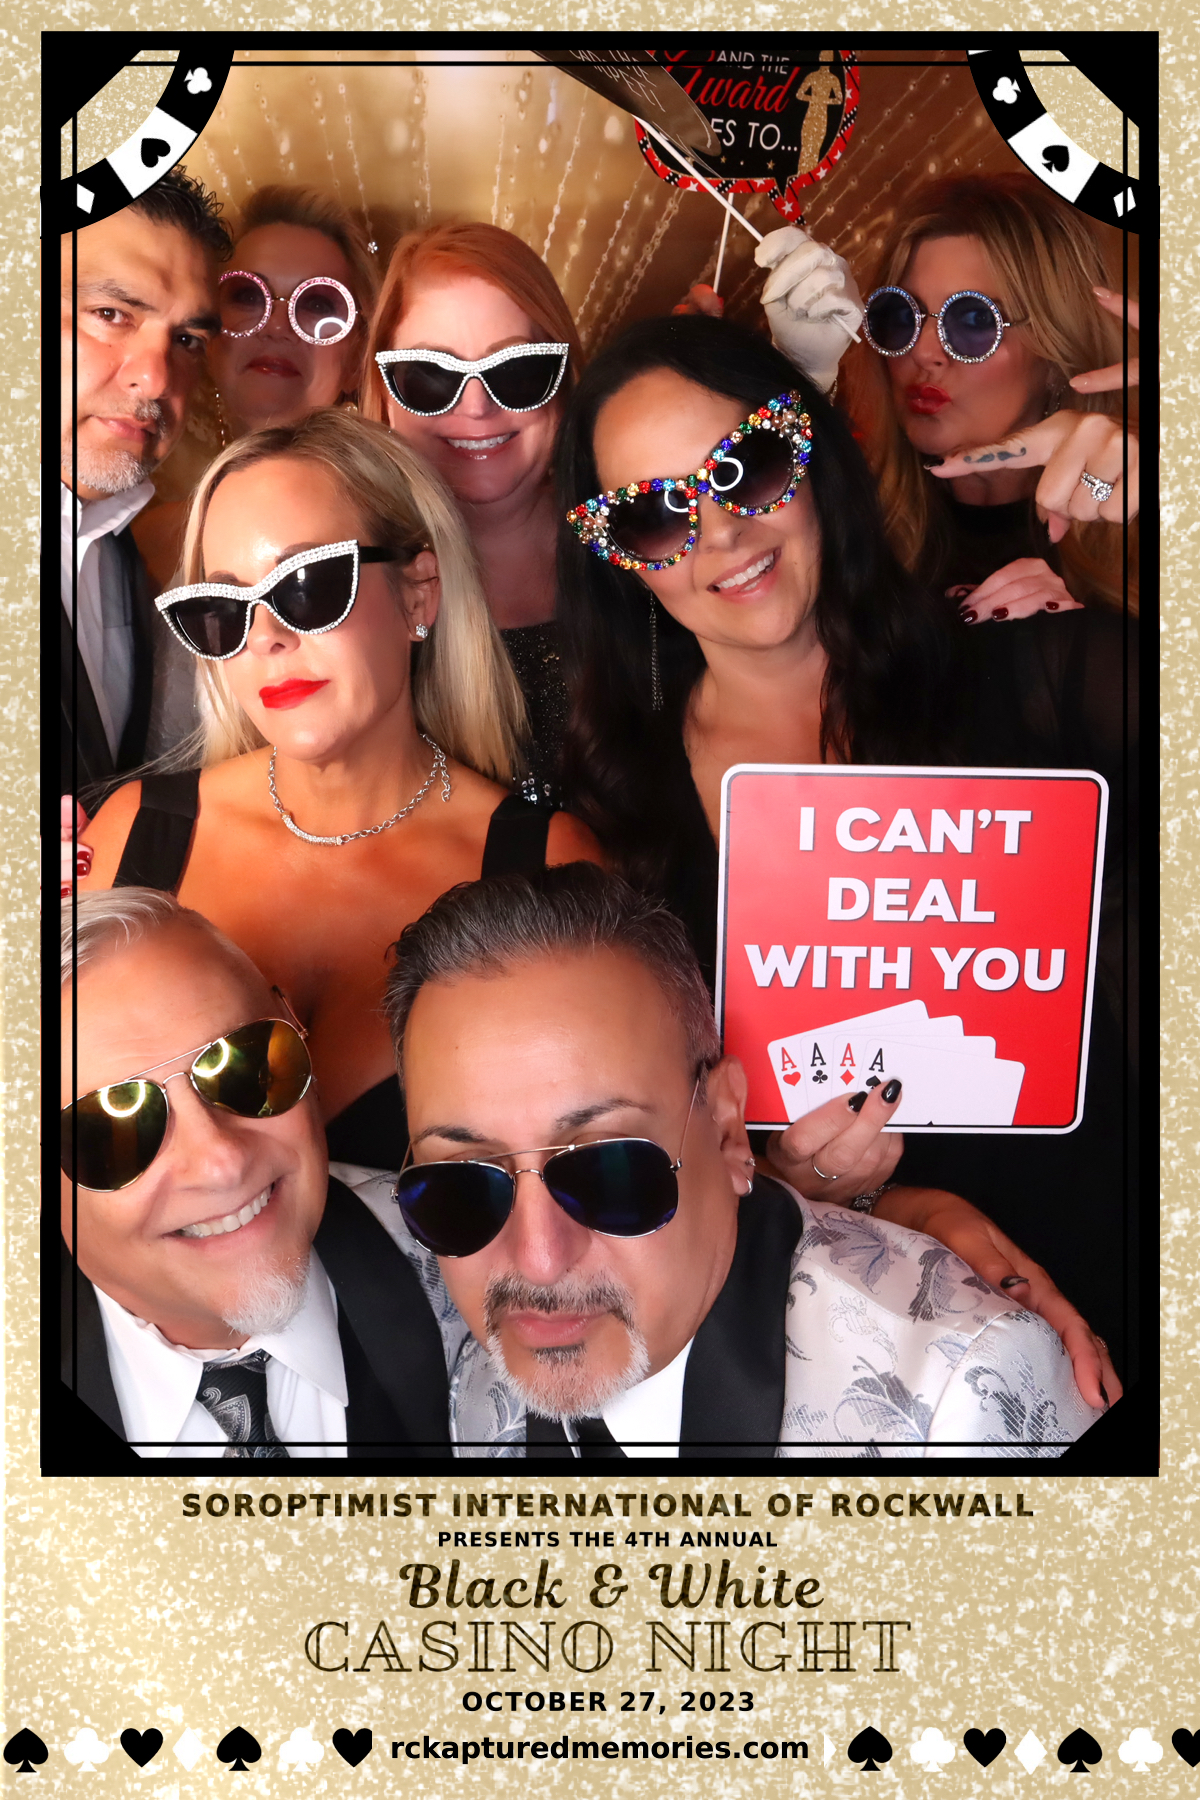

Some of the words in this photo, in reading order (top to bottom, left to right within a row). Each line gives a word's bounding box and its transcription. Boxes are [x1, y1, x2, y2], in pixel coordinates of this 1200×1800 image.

[716, 50, 755, 70] AND
[760, 54, 790, 75] THE
[748, 121, 798, 151] TO...
[799, 806, 817, 853] I
[835, 806, 1032, 855] CAN’T
[827, 876, 996, 923] DEAL
[744, 943, 912, 990] WITH
[930, 946, 1066, 992] YOU
[781, 1046, 797, 1071] A
[810, 1042, 826, 1067] A
[840, 1042, 856, 1067] A
[868, 1047, 885, 1072] A
